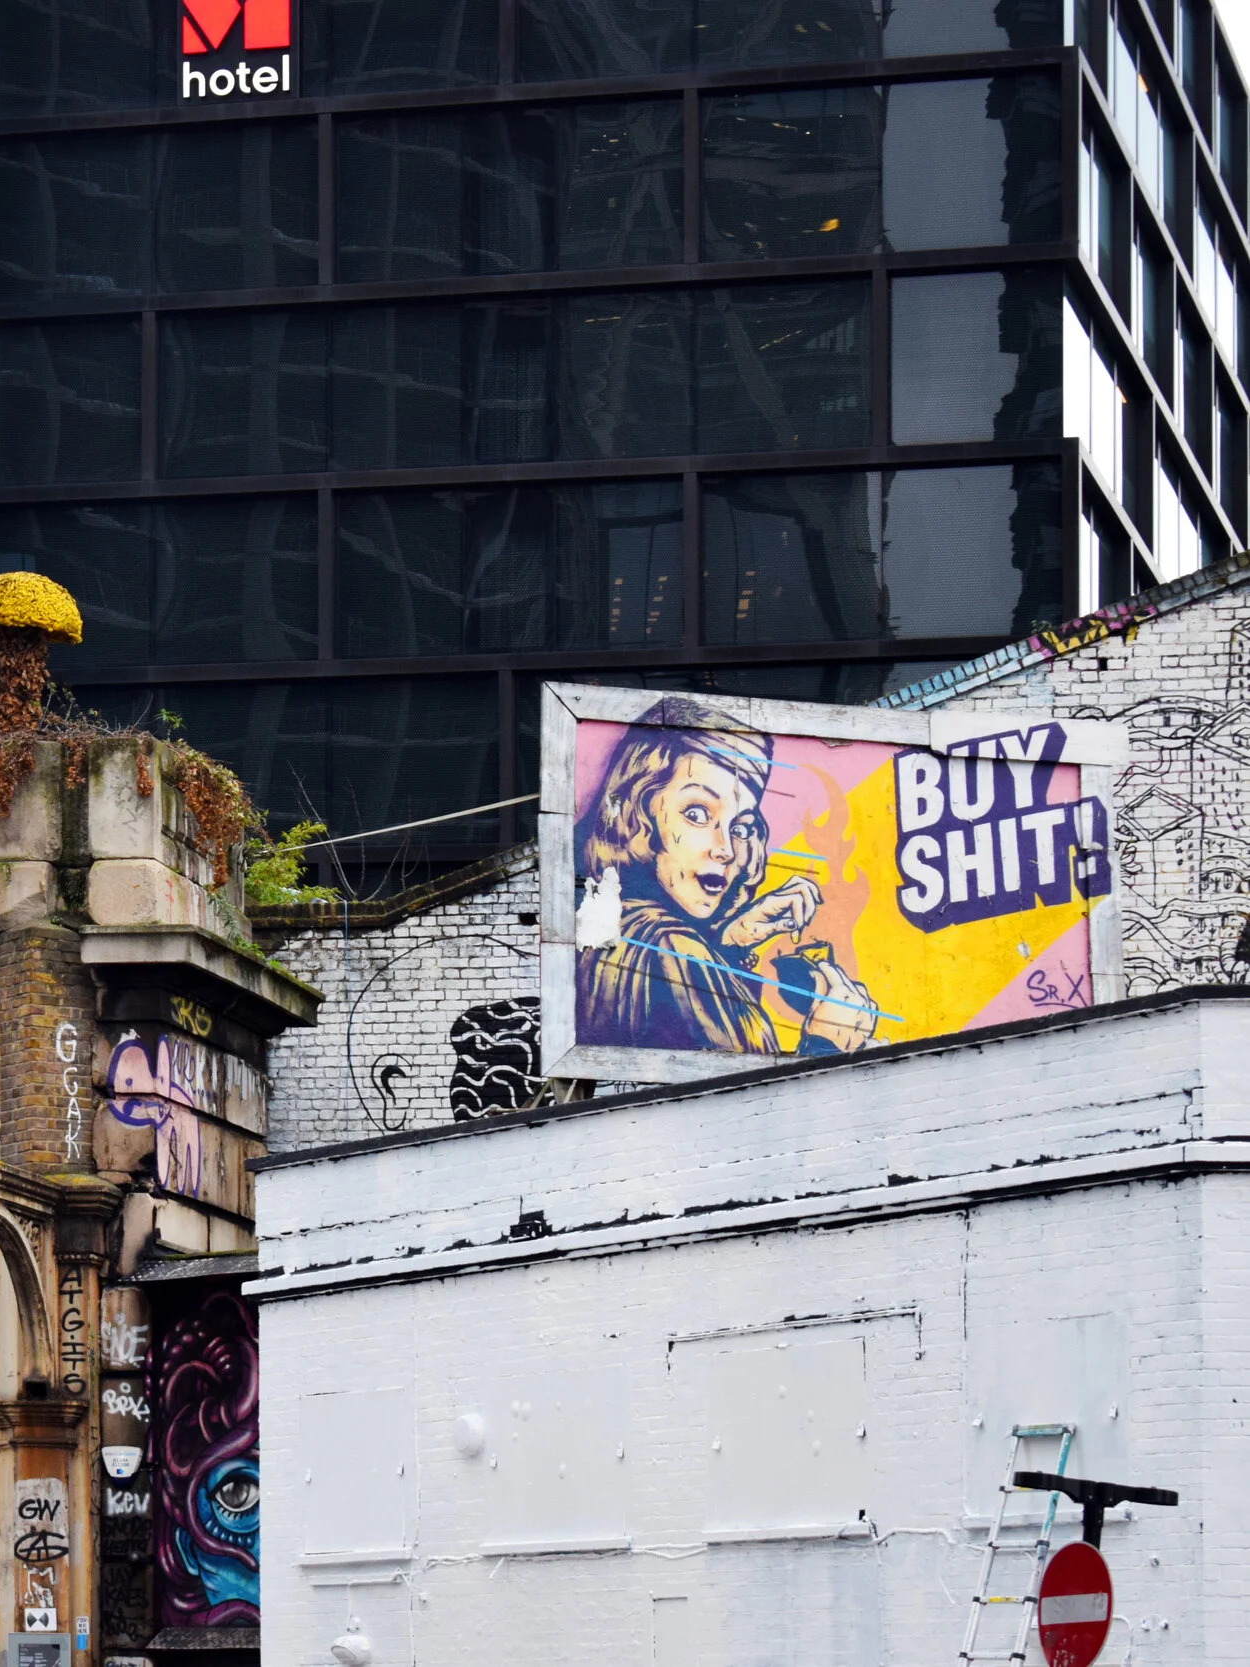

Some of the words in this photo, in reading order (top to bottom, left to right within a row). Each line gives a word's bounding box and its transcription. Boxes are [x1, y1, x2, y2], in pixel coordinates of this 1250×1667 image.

[182, 54, 291, 98] hotel
[896, 726, 1054, 833] BUY
[899, 801, 1098, 914] SHIT!
